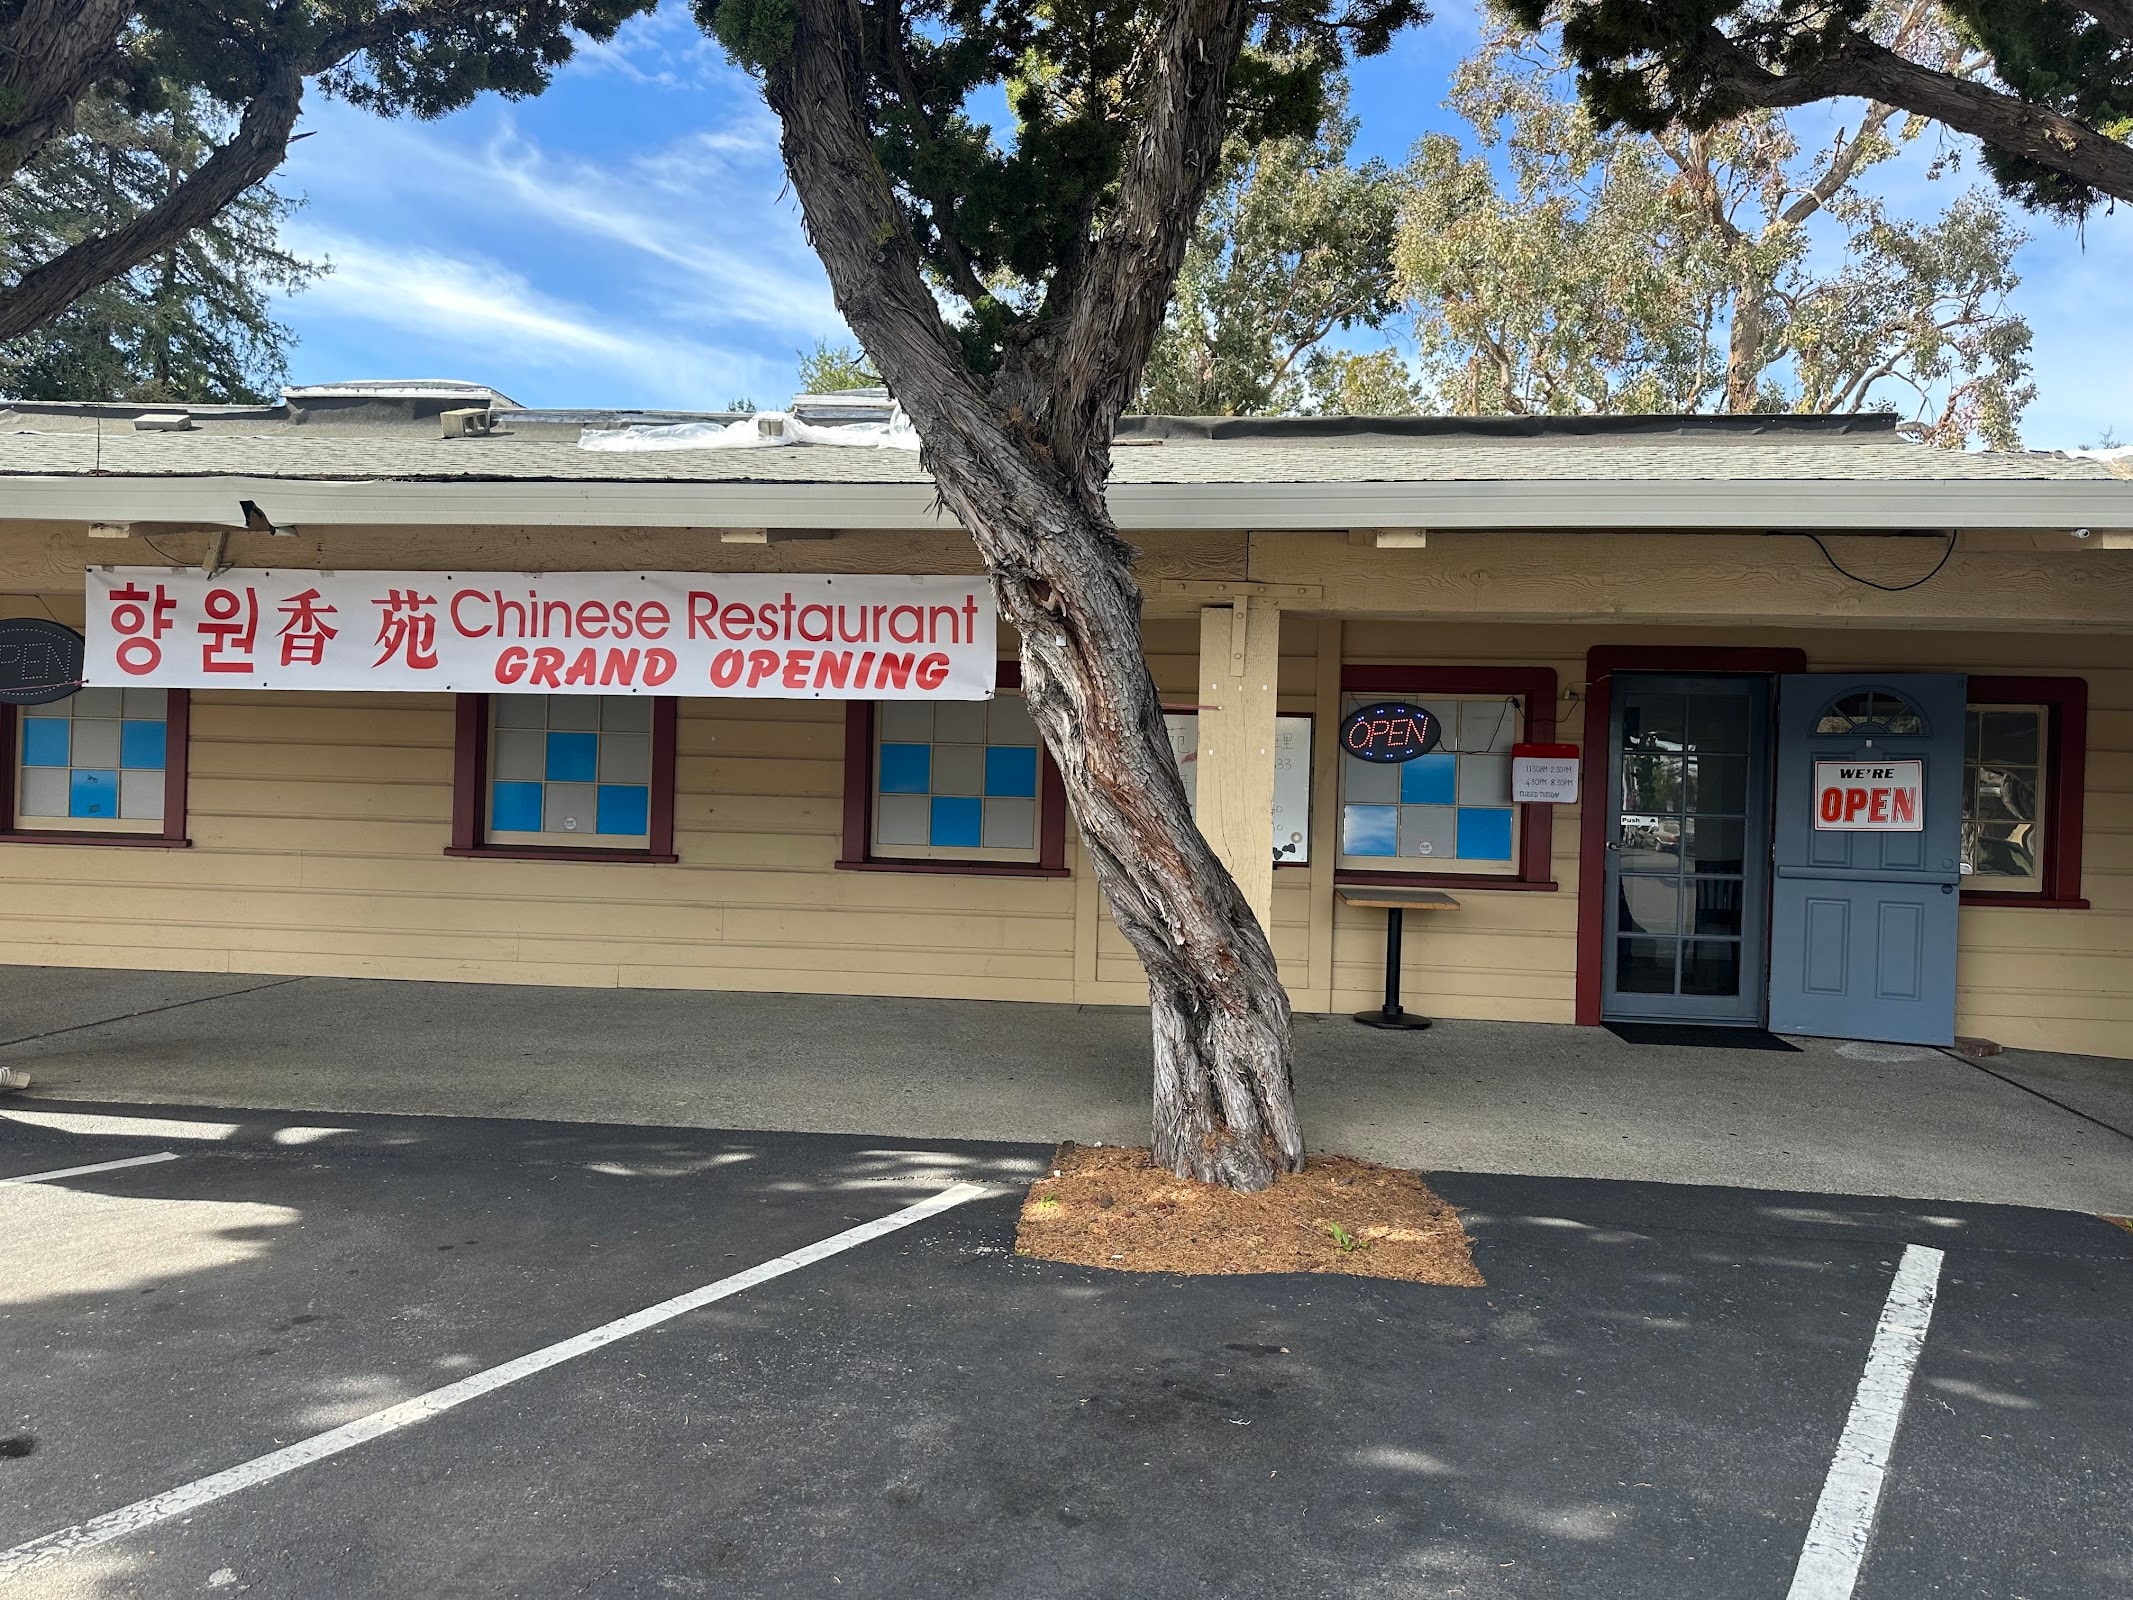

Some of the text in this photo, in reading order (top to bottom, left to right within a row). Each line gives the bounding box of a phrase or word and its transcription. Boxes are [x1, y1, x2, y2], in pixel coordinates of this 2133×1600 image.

[450, 588, 978, 645] Chinese Restaurant
[0, 640, 72, 683] PEN
[494, 646, 950, 691] GRAND OPENING
[1348, 716, 1430, 749] OPEN
[1839, 768, 1896, 779] WE'RE
[1820, 786, 1917, 824] OPEN
